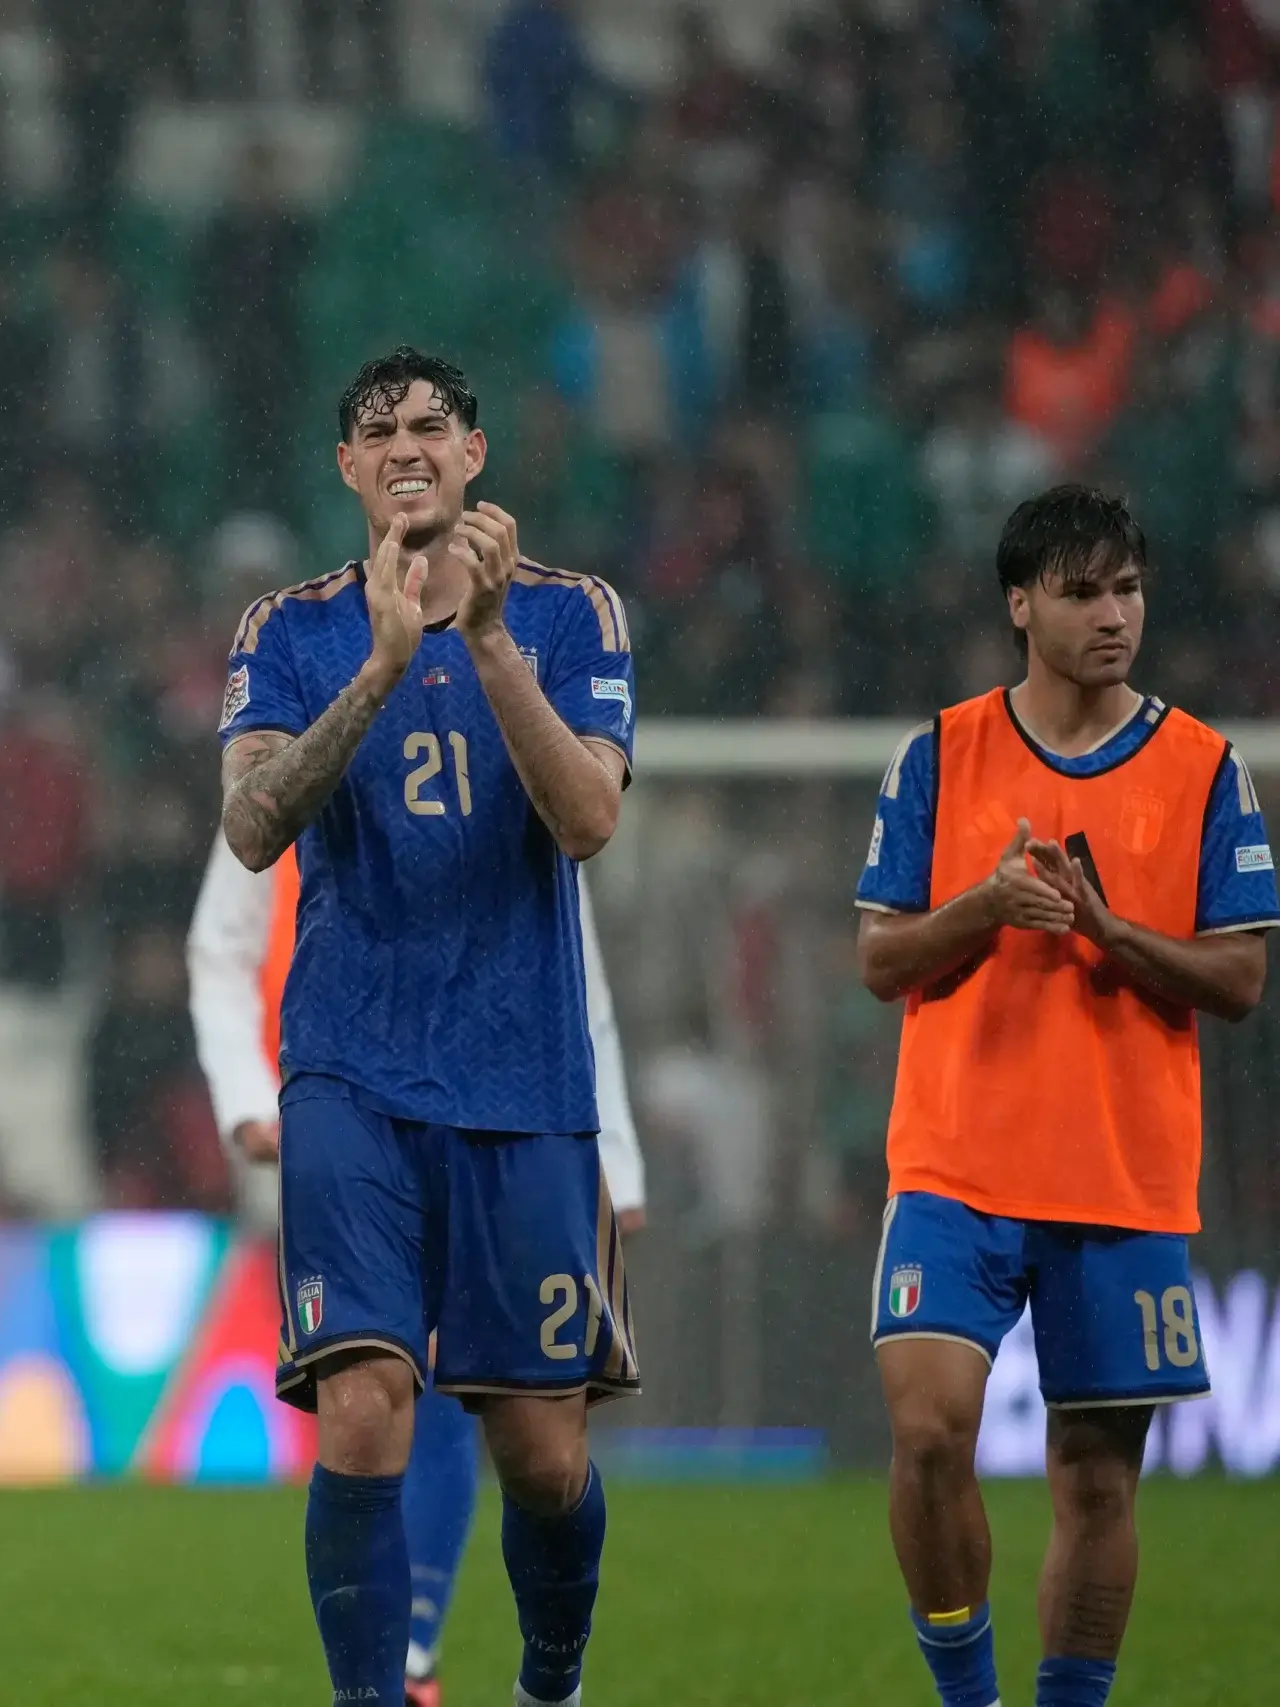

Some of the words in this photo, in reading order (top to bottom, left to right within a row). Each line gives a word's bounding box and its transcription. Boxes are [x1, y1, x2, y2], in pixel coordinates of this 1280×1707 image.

[403, 730, 472, 817] 21
[539, 1273, 603, 1360] 21
[1134, 1286, 1199, 1371] 18
[332, 1685, 380, 1701] TALIA
